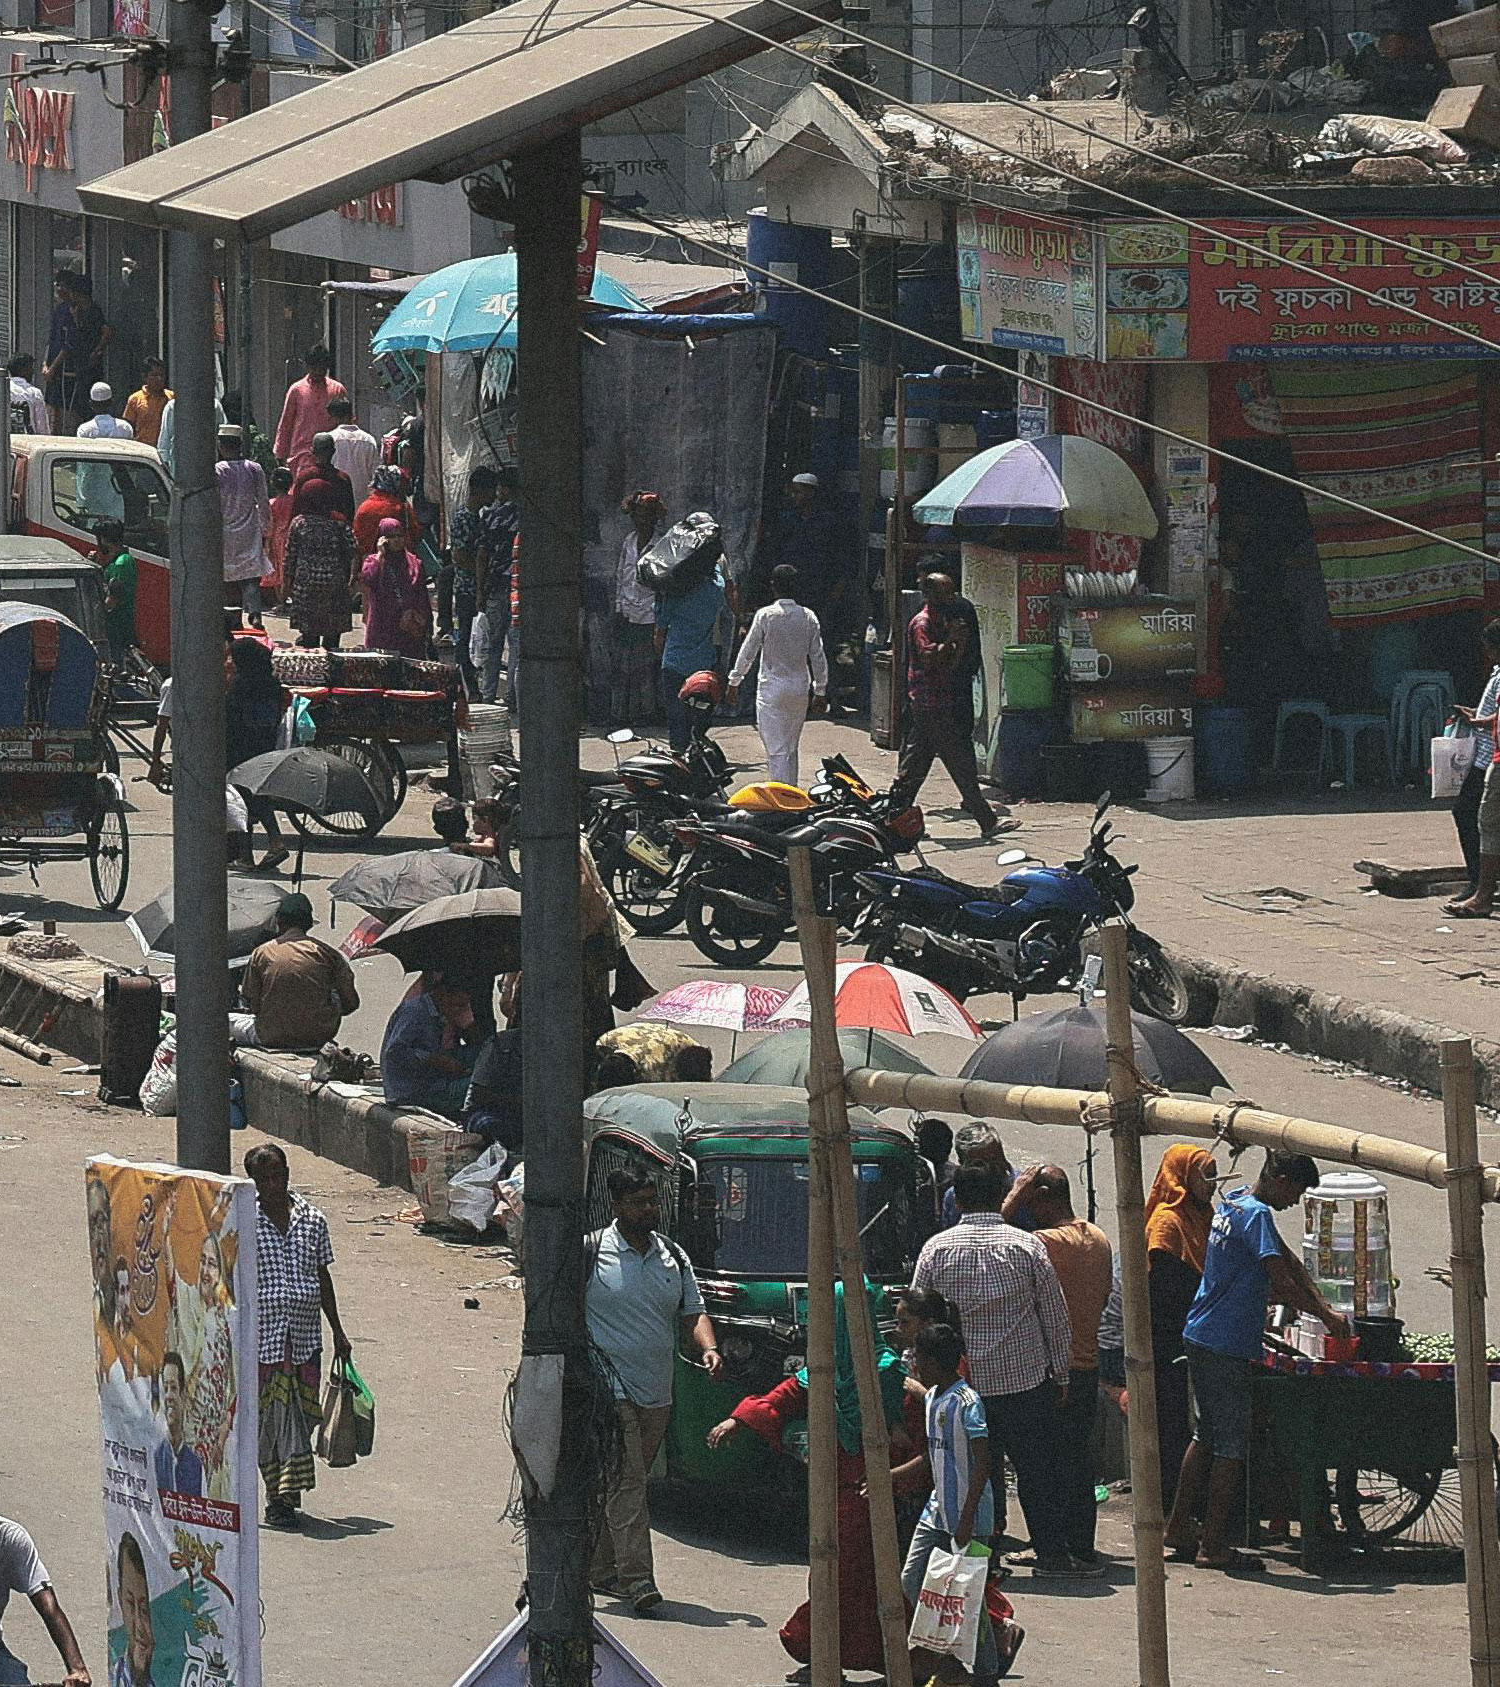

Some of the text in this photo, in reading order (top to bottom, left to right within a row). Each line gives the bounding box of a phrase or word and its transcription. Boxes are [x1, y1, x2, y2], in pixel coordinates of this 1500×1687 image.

[1215, 281, 1262, 314] দই
[1270, 287, 1351, 319] ফুচকা
[1120, 705, 1175, 726] মারিয়া
